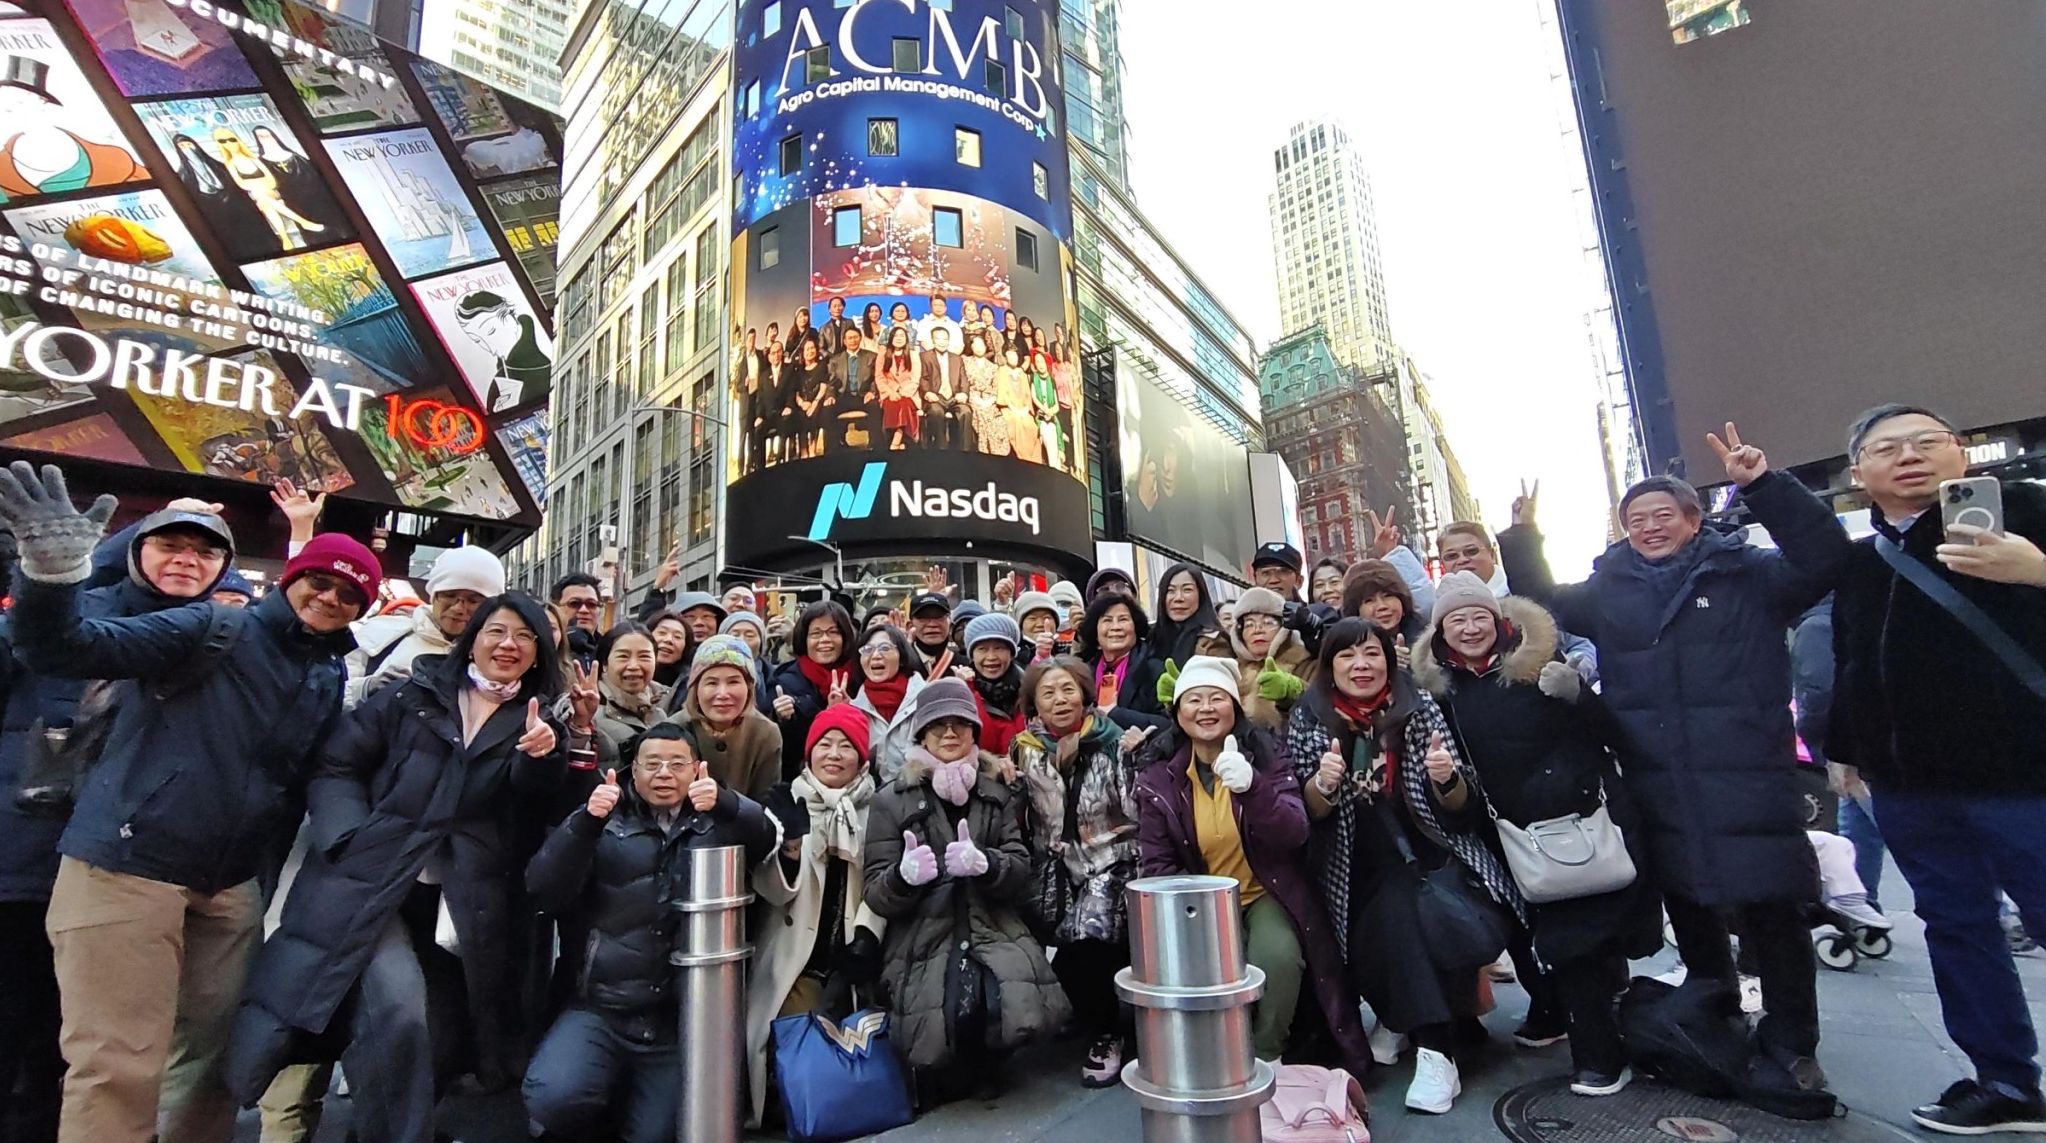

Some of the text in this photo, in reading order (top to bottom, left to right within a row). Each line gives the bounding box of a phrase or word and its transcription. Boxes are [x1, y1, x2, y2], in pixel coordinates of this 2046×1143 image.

[774, 0, 1047, 119] ACMB
[777, 76, 1035, 131] Agro Capital Management Corp
[342, 140, 433, 162] NEW YORKER
[495, 191, 525, 207] NEW
[31, 243, 68, 262] OF
[78, 252, 224, 298] LANDMARK
[230, 289, 332, 326] WRITING.
[42, 266, 80, 286] OF
[89, 276, 181, 308] ICONIC
[190, 300, 319, 340] CARTOONS.
[426, 272, 511, 302] NEW YORKER
[40, 286, 181, 328] CHANGING
[190, 317, 237, 341] THE
[245, 332, 350, 365] CULTURE.
[288, 376, 375, 431] AT
[384, 394, 487, 454] 100
[507, 421, 535, 442] NEW
[890, 480, 1040, 535] Nasdaq
